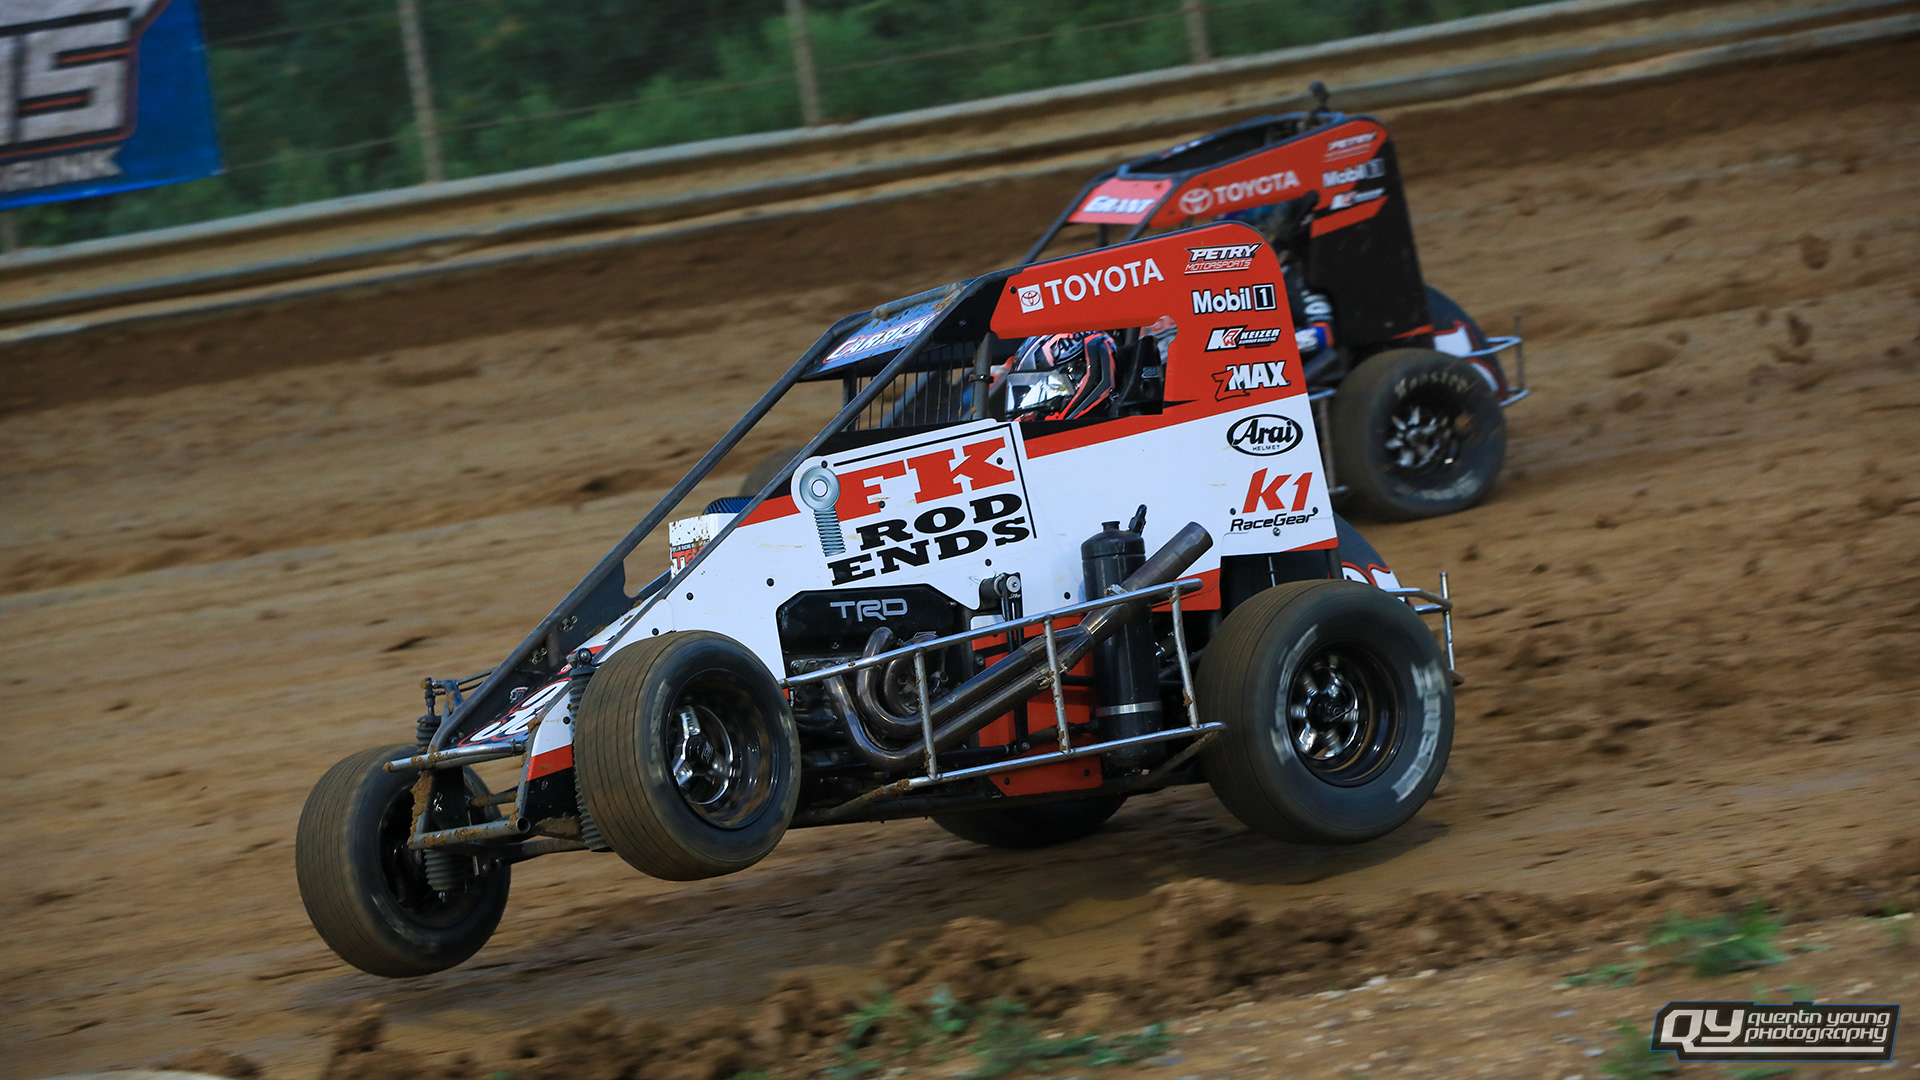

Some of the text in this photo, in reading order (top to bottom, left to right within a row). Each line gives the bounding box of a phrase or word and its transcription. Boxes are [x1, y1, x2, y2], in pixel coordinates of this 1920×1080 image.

[1213, 171, 1301, 204] TOYOTA
[1322, 163, 1366, 188] Mobil
[1184, 259, 1252, 271] MOTORSPORTS
[1188, 243, 1262, 262] PETRY
[1044, 258, 1165, 305] TOYOTA
[1191, 287, 1252, 314] Mobil
[1240, 328, 1280, 340] KEIZER
[1232, 419, 1294, 446] Arai
[834, 437, 1016, 522] FK
[1242, 468, 1313, 513] K1
[855, 493, 1023, 551] ROD
[1230, 511, 1317, 532] RaceGear
[827, 516, 1030, 586] ENDS
[830, 598, 908, 622] TRD
